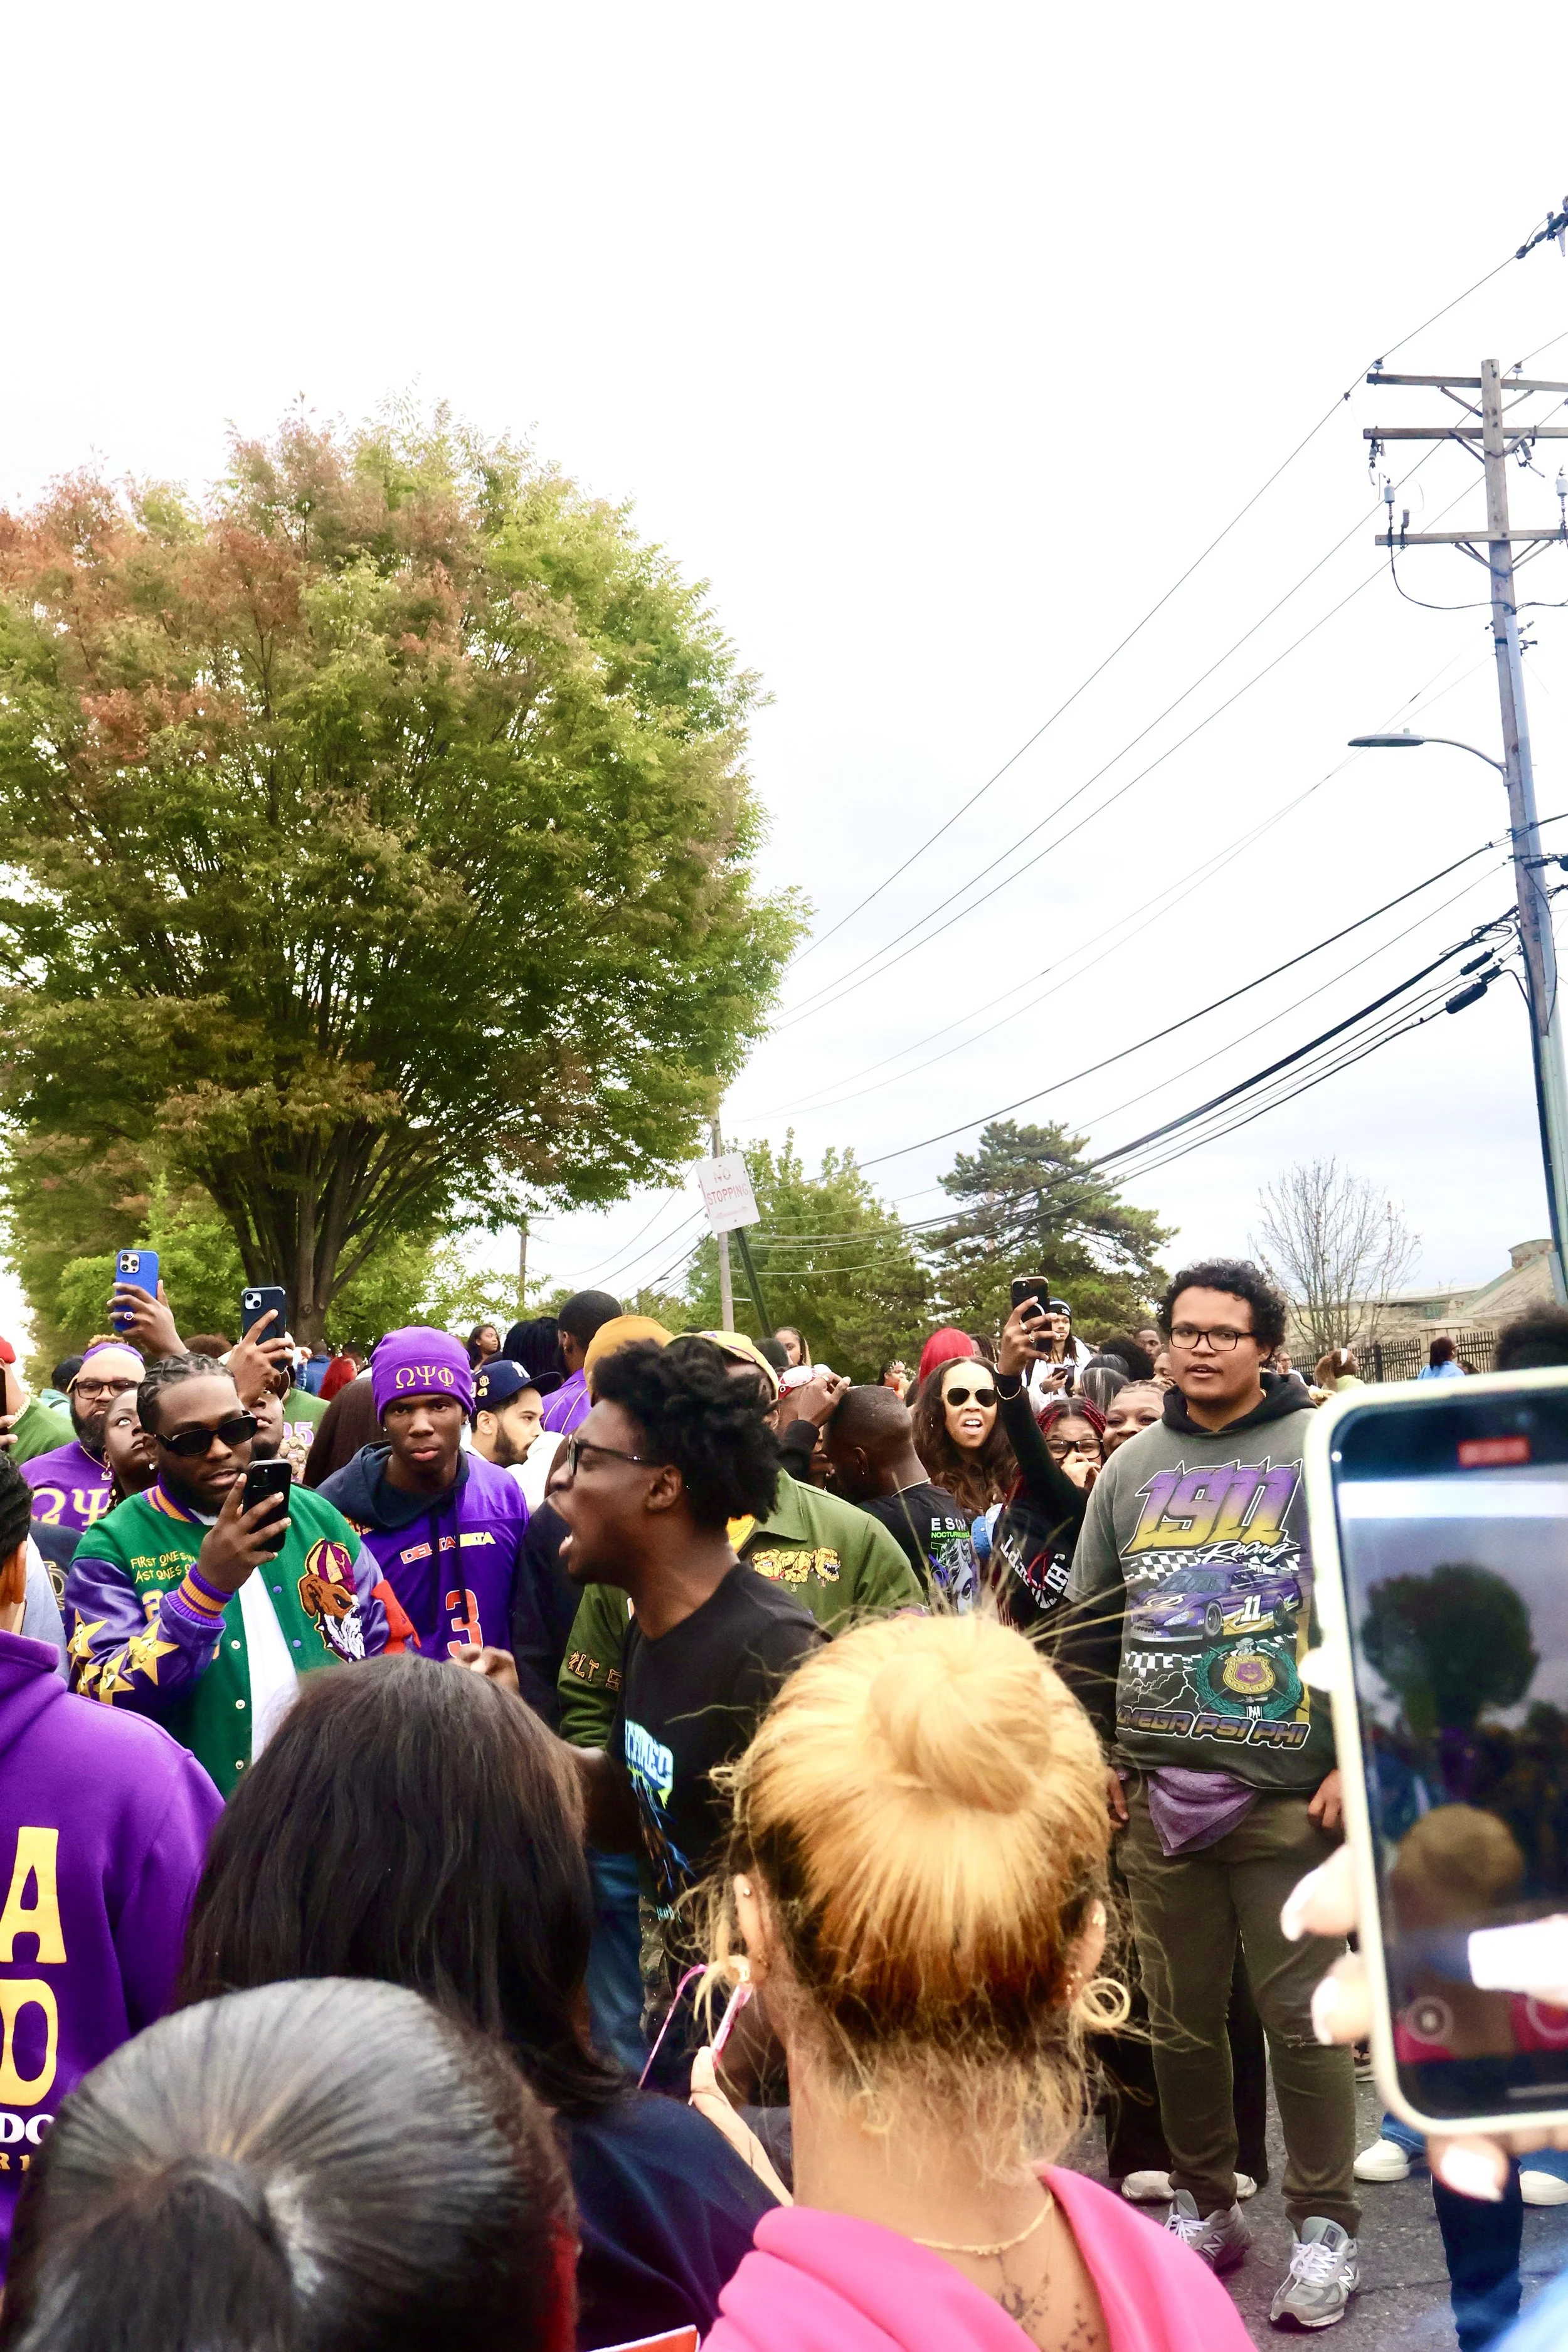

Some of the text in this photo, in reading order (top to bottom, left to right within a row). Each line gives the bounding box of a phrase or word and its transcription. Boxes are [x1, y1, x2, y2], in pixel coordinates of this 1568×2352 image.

[712, 1167, 731, 1184] NO
[706, 1183, 750, 1205] STOPPING
[396, 1365, 455, 1389] ΩΨΦ
[1120, 1456, 1303, 1560] 1911
[130, 1556, 156, 1569] FIRST
[1194, 1540, 1301, 1564] Racing
[1240, 1594, 1262, 1623] 11
[446, 1589, 484, 1659] 3
[1190, 1713, 1254, 1744] PSI
[1248, 1719, 1311, 1749] PHI
